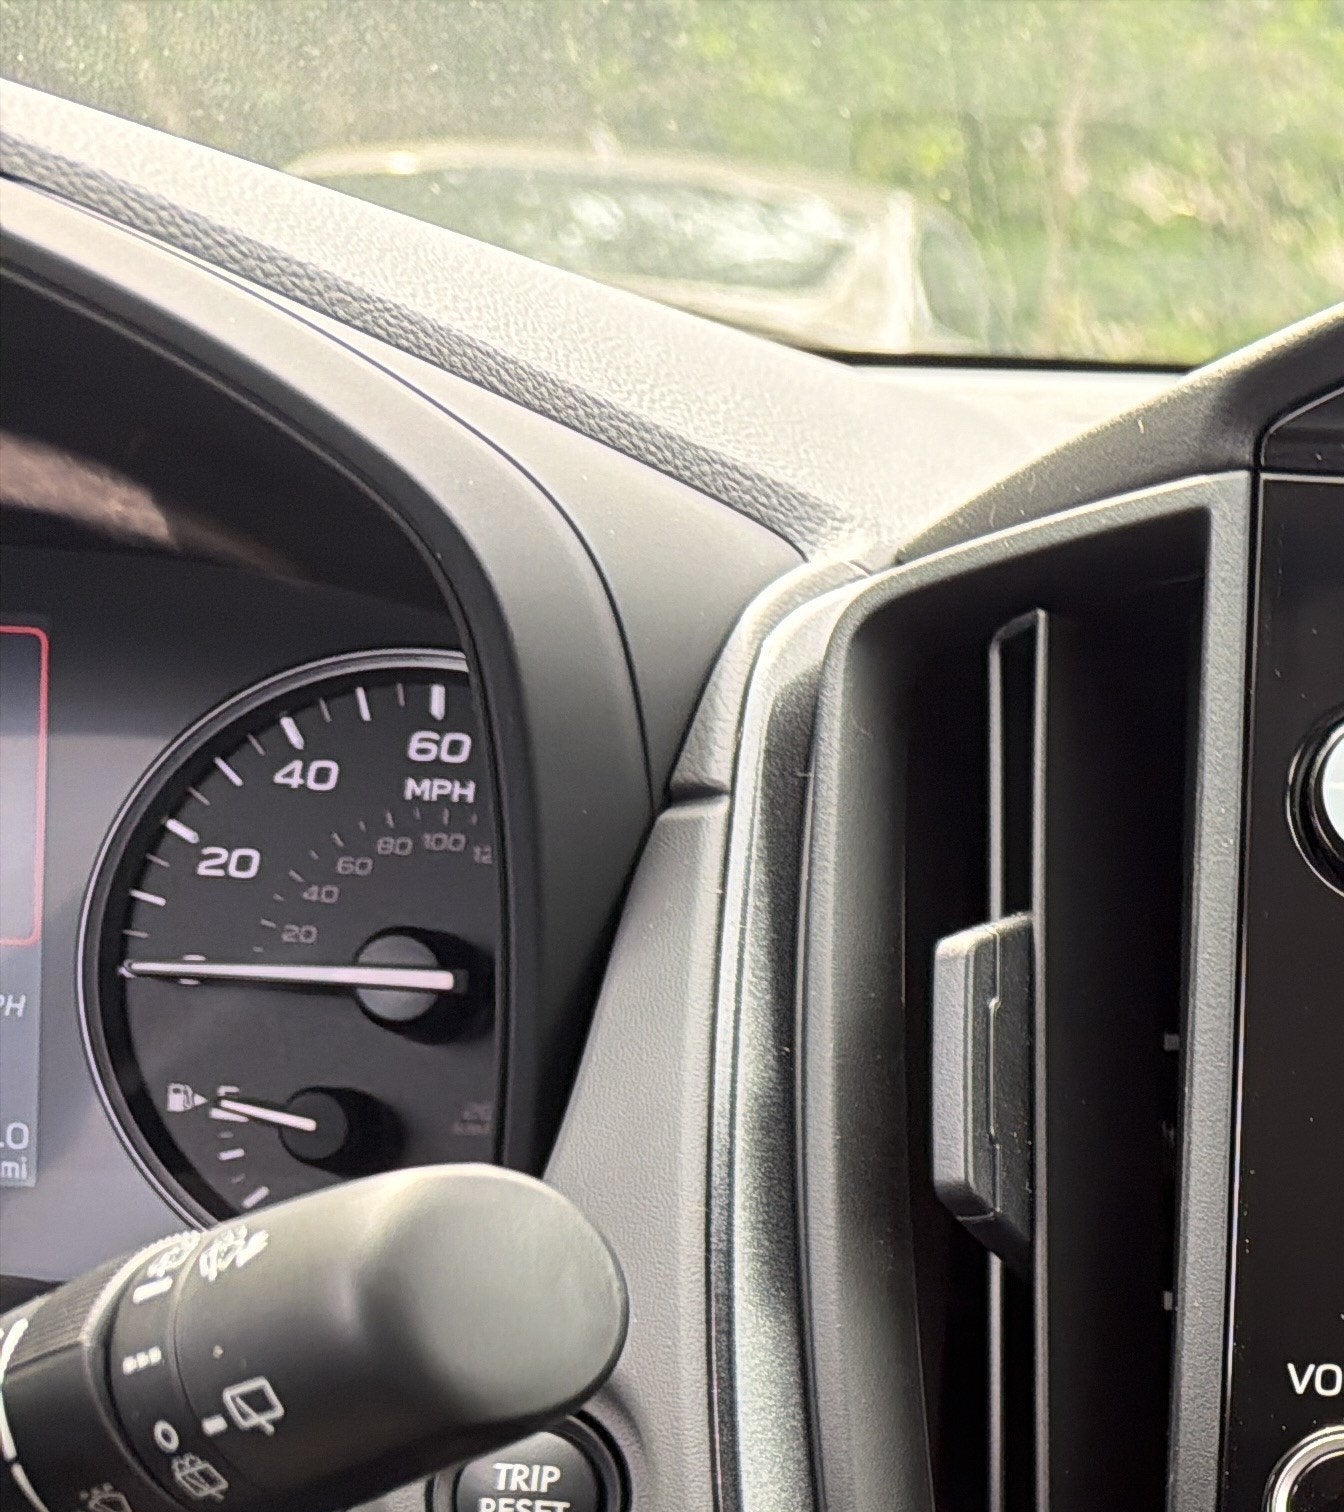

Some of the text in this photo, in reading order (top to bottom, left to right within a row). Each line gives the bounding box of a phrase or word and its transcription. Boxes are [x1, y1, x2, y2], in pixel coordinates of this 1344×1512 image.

[407, 733, 472, 764] 60
[273, 760, 340, 791] 40
[404, 778, 475, 803] MPH
[377, 836, 413, 856] 80
[196, 847, 260, 879] 20
[337, 857, 373, 876] 60
[303, 885, 339, 904] 40
[282, 925, 318, 944] 20
[495, 1463, 561, 1493] TRIP
